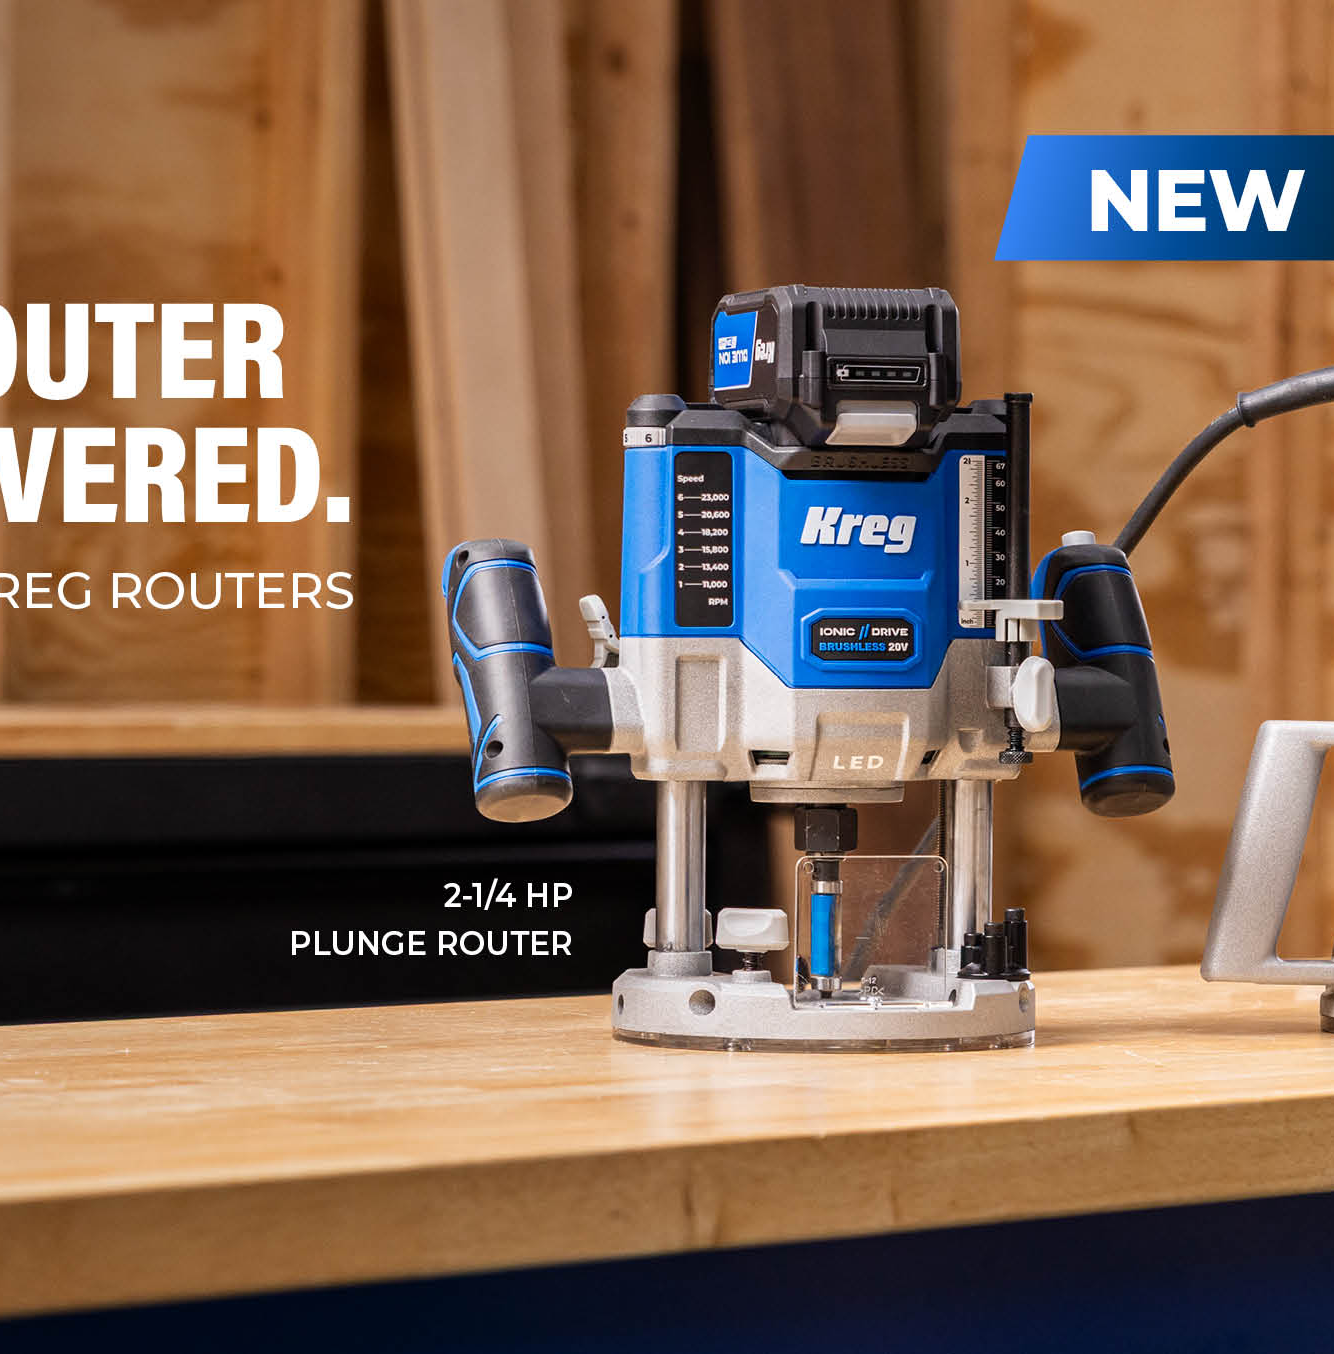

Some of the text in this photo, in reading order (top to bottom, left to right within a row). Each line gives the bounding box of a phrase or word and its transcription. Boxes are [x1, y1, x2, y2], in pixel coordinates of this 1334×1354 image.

[644, 433, 652, 444] 6
[995, 462, 1006, 470] 67
[677, 474, 704, 483] Speed
[995, 504, 1006, 512] 50
[800, 506, 917, 554] Kreg
[995, 529, 1006, 537] 40
[995, 554, 1006, 562] 30
[995, 579, 1006, 587] 20
[820, 628, 908, 636] IONIC DRIVE
[819, 642, 908, 652] BRUSHLESS 20V
[833, 755, 884, 769] LED
